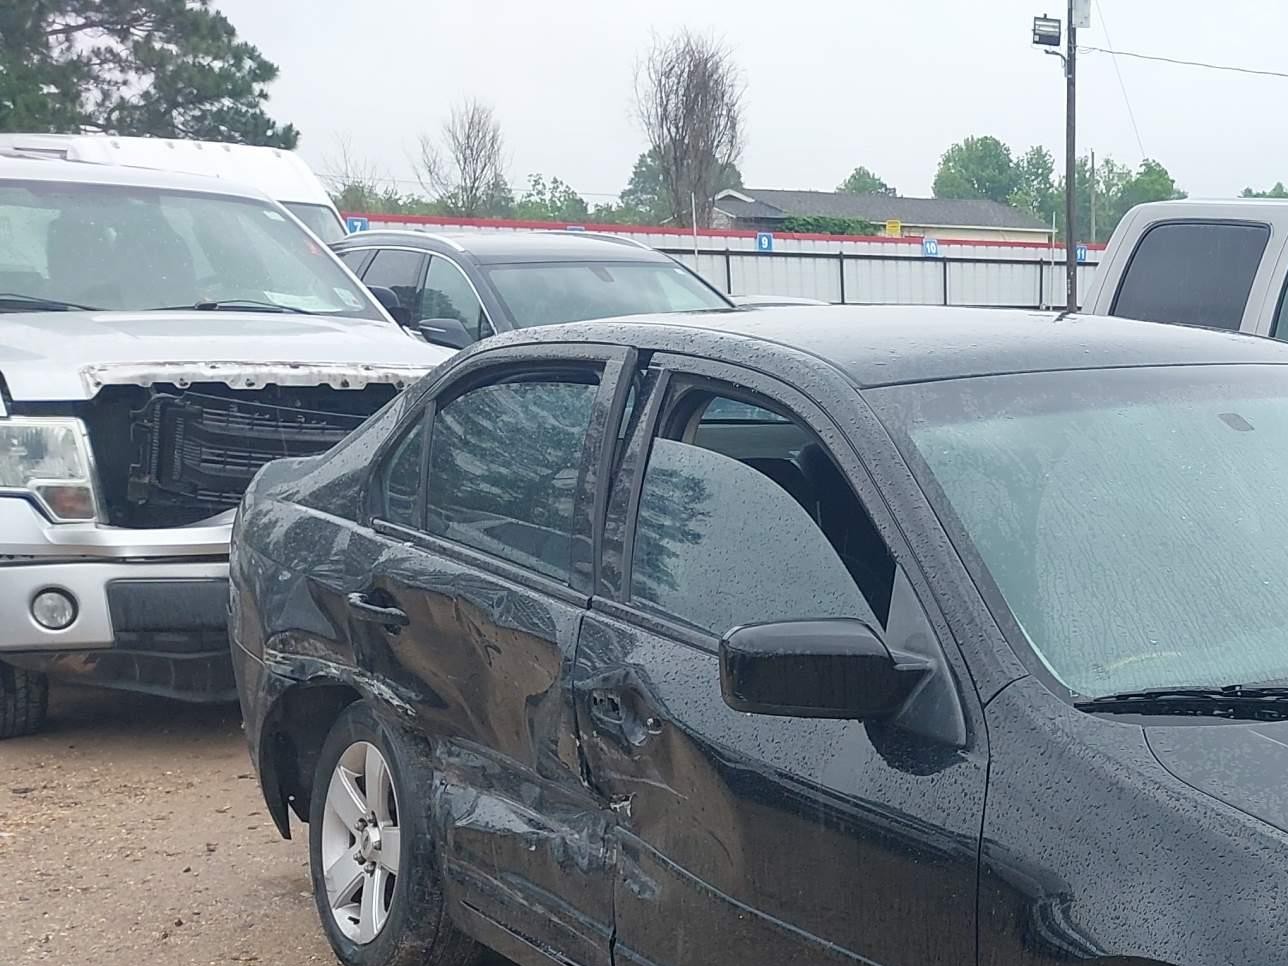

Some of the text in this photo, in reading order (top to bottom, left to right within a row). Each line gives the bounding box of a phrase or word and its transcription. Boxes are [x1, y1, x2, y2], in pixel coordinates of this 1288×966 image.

[353, 221, 362, 232] 7
[761, 236, 769, 249] 9
[926, 242, 937, 255] 10
[1076, 248, 1086, 260] 11
